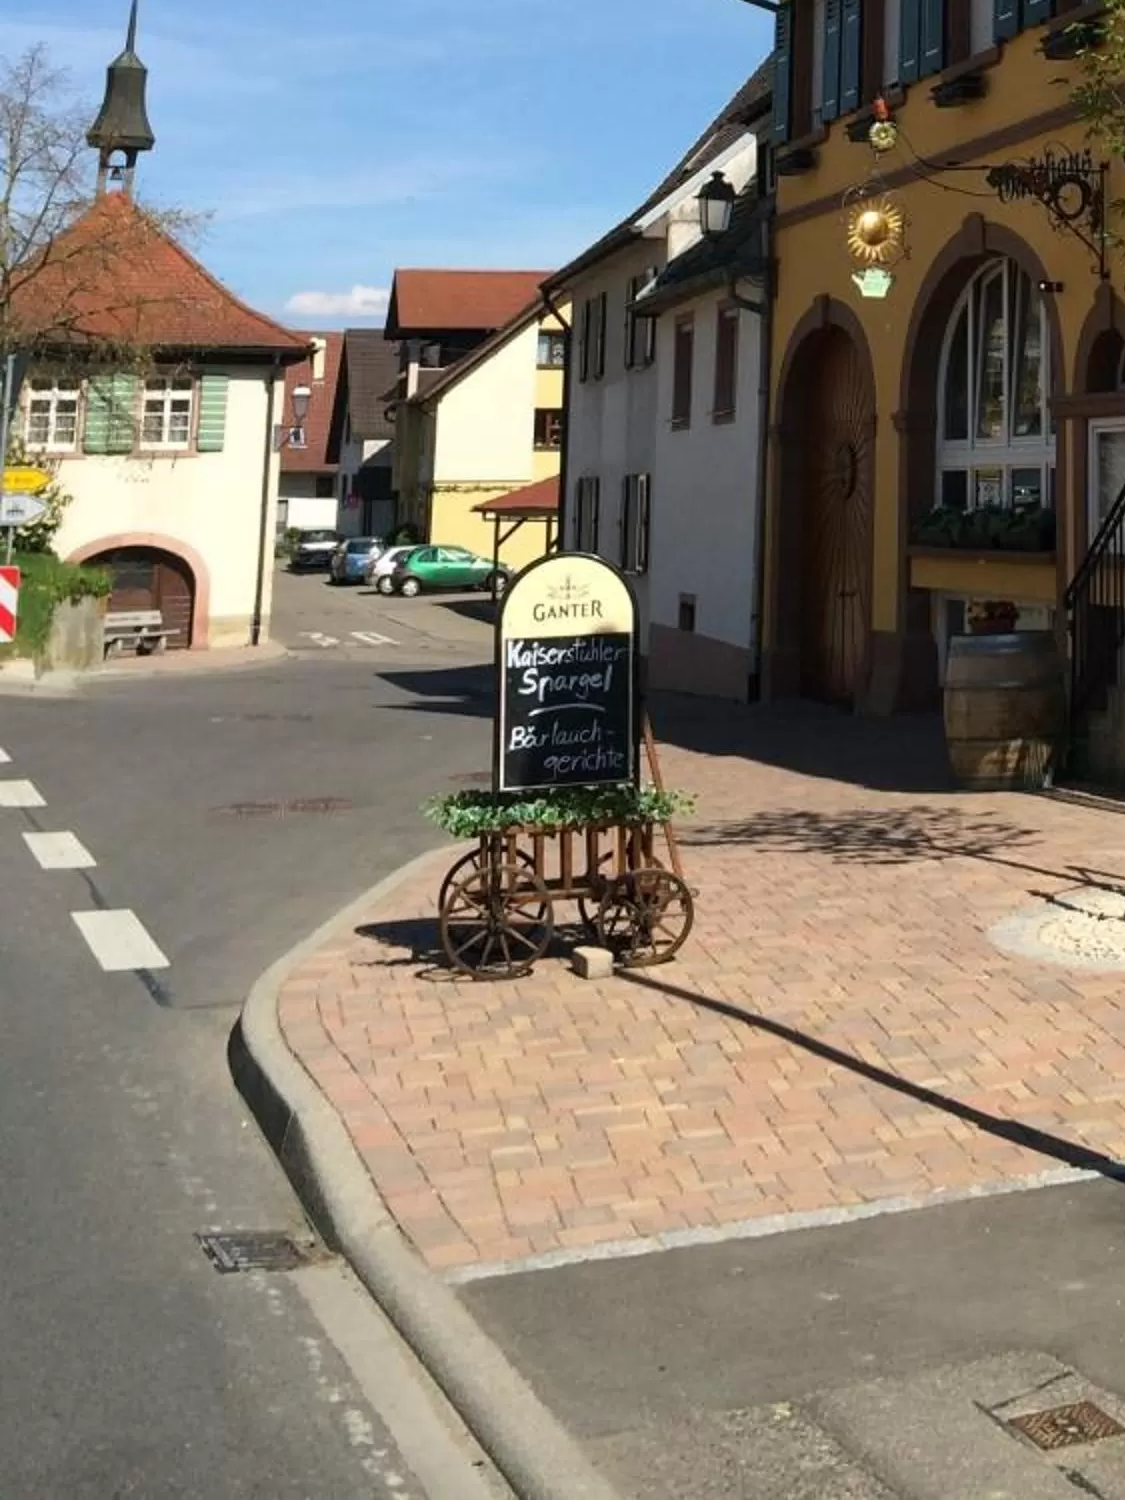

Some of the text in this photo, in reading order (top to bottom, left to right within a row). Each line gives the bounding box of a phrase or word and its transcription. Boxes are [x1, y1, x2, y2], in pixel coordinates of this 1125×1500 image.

[533, 599, 604, 622] GANTER
[518, 664, 613, 702] Spargel
[543, 752, 625, 781] gerichte
